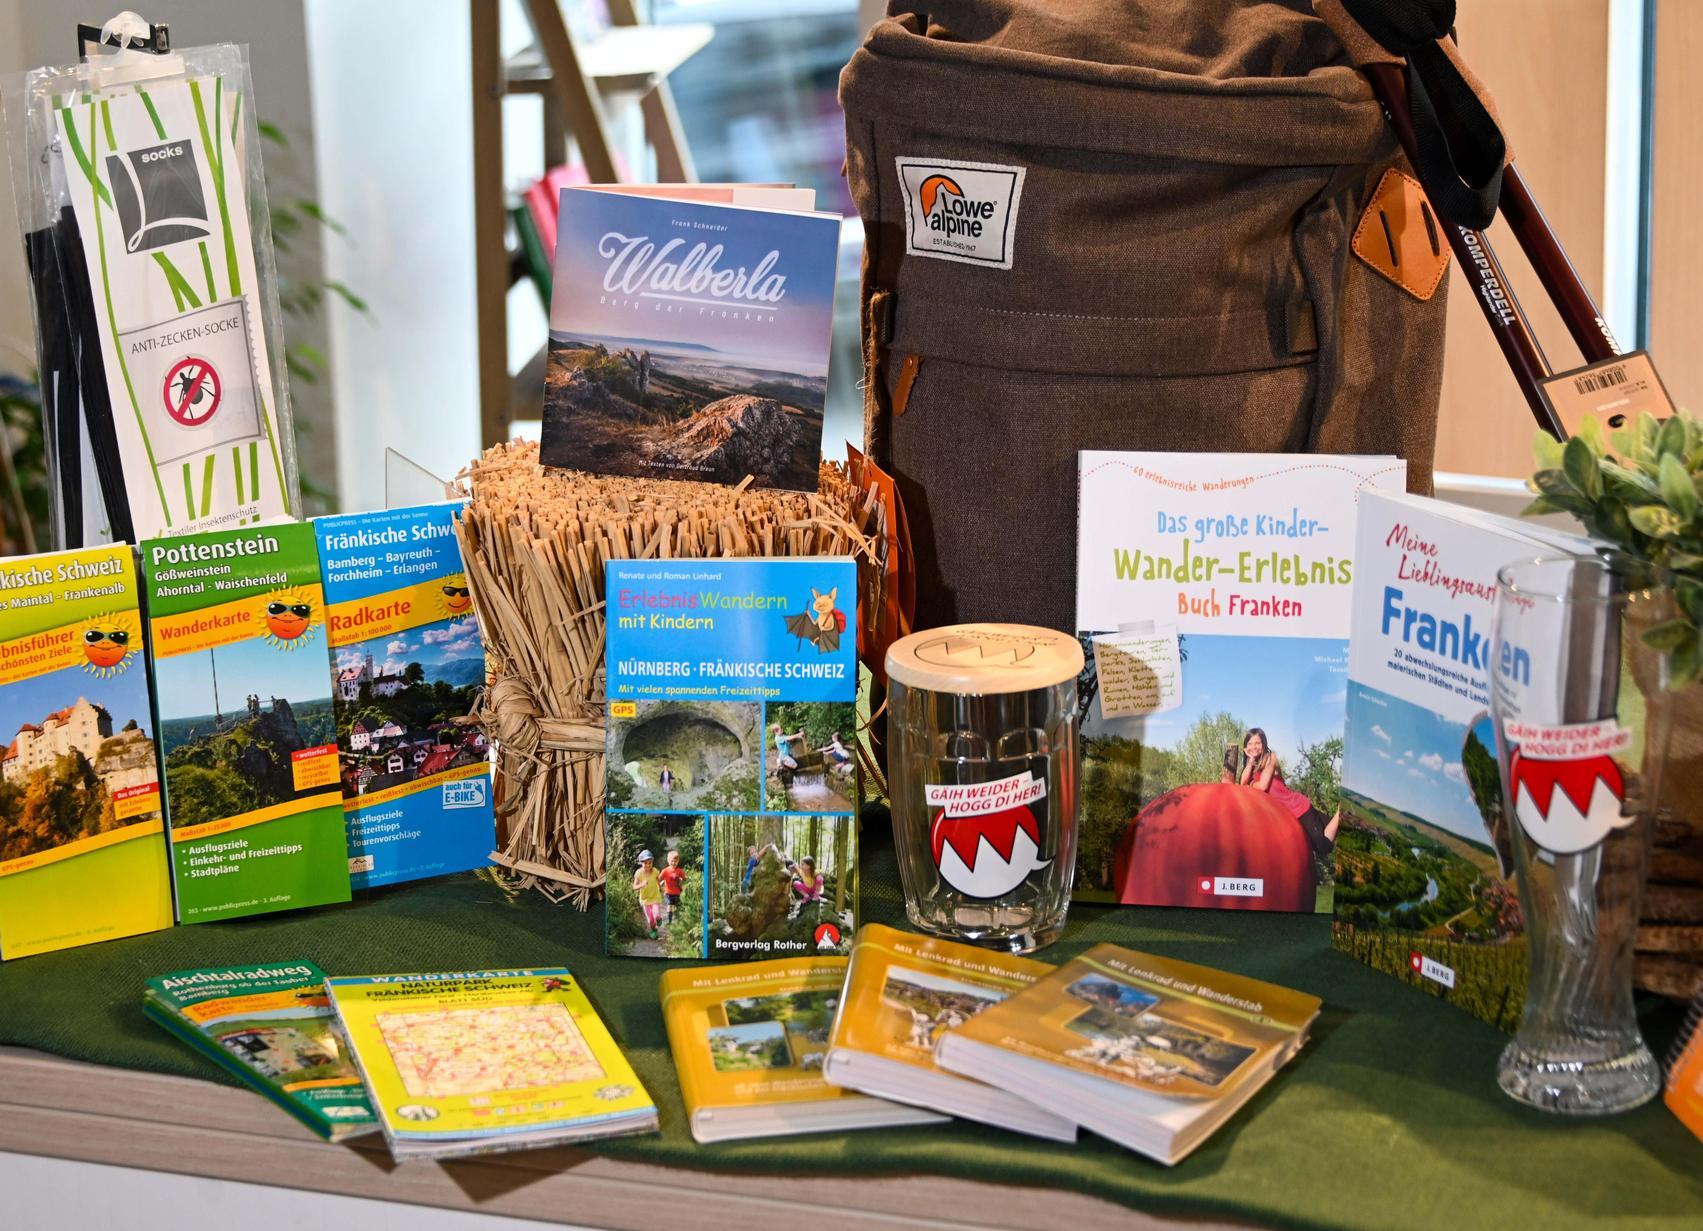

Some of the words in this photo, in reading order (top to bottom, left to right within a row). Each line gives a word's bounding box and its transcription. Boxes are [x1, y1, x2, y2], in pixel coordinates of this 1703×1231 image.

[141, 146, 184, 163] socks
[671, 219, 691, 229] Frank
[693, 221, 729, 232] Schneider
[931, 210, 982, 238] alpine
[933, 238, 966, 250] ESTABLISHED
[599, 231, 786, 303] Walberla
[1458, 225, 1516, 325] KOMPERDELL
[600, 296, 640, 311] Berg
[655, 301, 685, 313] der
[699, 308, 776, 323] Franken
[131, 317, 239, 355] ANTI-ZECKEN-SOCKE
[1133, 465, 1144, 477] 60
[1145, 471, 1198, 493] erlebnisreiche
[1202, 476, 1255, 492] Wanderungen
[199, 506, 258, 530] Insektenschutz
[1157, 511, 1188, 534] Das
[1195, 516, 1249, 543] große
[1255, 508, 1329, 538] Kinder-
[325, 526, 408, 550] Fränkische
[412, 521, 456, 541] Schw
[1386, 523, 1438, 557] Meine
[152, 534, 279, 566] Pottenstein
[327, 555, 376, 570] Bamberg
[386, 548, 433, 563] Bayreuth
[0, 566, 53, 590] kische
[57, 555, 123, 582] Schweiz
[155, 564, 231, 582] Gößweinstein
[328, 567, 383, 583] Forchheim
[393, 561, 438, 576] Erlangen
[1114, 538, 1352, 586] Wander-Erlebnis
[156, 582, 205, 598] Ahorntal
[214, 572, 288, 591] Waischenfeld
[618, 572, 645, 581] Renate
[646, 572, 662, 581] und
[664, 572, 691, 581] Roman
[692, 572, 722, 581] Linhard
[11, 592, 54, 609] Maintal
[64, 582, 126, 601] Frankenalb
[1178, 588, 1221, 617] Buch
[1229, 594, 1302, 618] Franken
[160, 610, 251, 641] Wanderkarte
[330, 599, 412, 632] Radkarte
[619, 614, 646, 629] mit
[650, 613, 714, 630] Kindern
[48, 645, 72, 659] Ziele
[618, 657, 690, 677] NÜRNBERG
[699, 659, 784, 678] FRÄNKISCHE
[785, 663, 845, 679] SCHWEIZ
[1393, 648, 1403, 658] 20
[1404, 654, 1468, 683] abwechslungsreiche
[1387, 660, 1426, 681] malerischen
[1428, 674, 1453, 691] Städten
[1455, 686, 1468, 697] und
[618, 684, 635, 694] Mit
[637, 684, 663, 694] vielen
[665, 686, 718, 697] spannenden
[720, 685, 781, 697] Freizeittipps
[613, 706, 634, 715] GPS
[1541, 726, 1601, 740] WEIDER
[1525, 743, 1567, 755] HOGG
[1571, 743, 1589, 754] DI
[128, 785, 150, 797] Original
[444, 790, 475, 803] E-BIKE
[445, 782, 461, 791] auch
[463, 781, 473, 790] für
[930, 787, 964, 801] GÄIH
[967, 778, 1020, 799] WEIDER
[949, 799, 991, 813] HOGG
[995, 795, 1011, 808] DI
[1013, 783, 1042, 803] HER!
[351, 810, 404, 826] Ausflugsziele
[352, 822, 401, 837] Freizeittipps
[352, 829, 422, 848] Tourenvorschläge
[189, 839, 249, 855] Ausflugsziele
[189, 854, 228, 867] Einkehr-
[229, 851, 247, 862] und
[249, 843, 303, 859] Freizeittipps
[191, 864, 240, 879] Stadtpläne
[715, 938, 771, 952] Bergverlag
[774, 939, 808, 950] Rother
[894, 943, 913, 955] Mit
[916, 949, 961, 968] Lenkrad
[963, 961, 987, 973] und
[162, 965, 313, 990] Aischtalradweg
[172, 983, 237, 996] Rothenburg
[239, 980, 252, 988] ob
[255, 979, 272, 987] der
[274, 976, 309, 986] Tauber
[371, 970, 534, 983] WANDERKARTE
[401, 979, 493, 989] NATURPARK
[692, 979, 712, 988] Mit
[715, 973, 760, 985] Lenkrad
[764, 970, 786, 979] und
[1107, 959, 1127, 971] Mit
[1128, 965, 1172, 986] Lenkrad
[1173, 979, 1197, 994] und
[1197, 985, 1263, 1013] Wanderstab
[179, 988, 230, 1001] Bamberg
[366, 985, 461, 998] FRÄNKISCHE
[465, 982, 533, 992] SCHWEIZ
